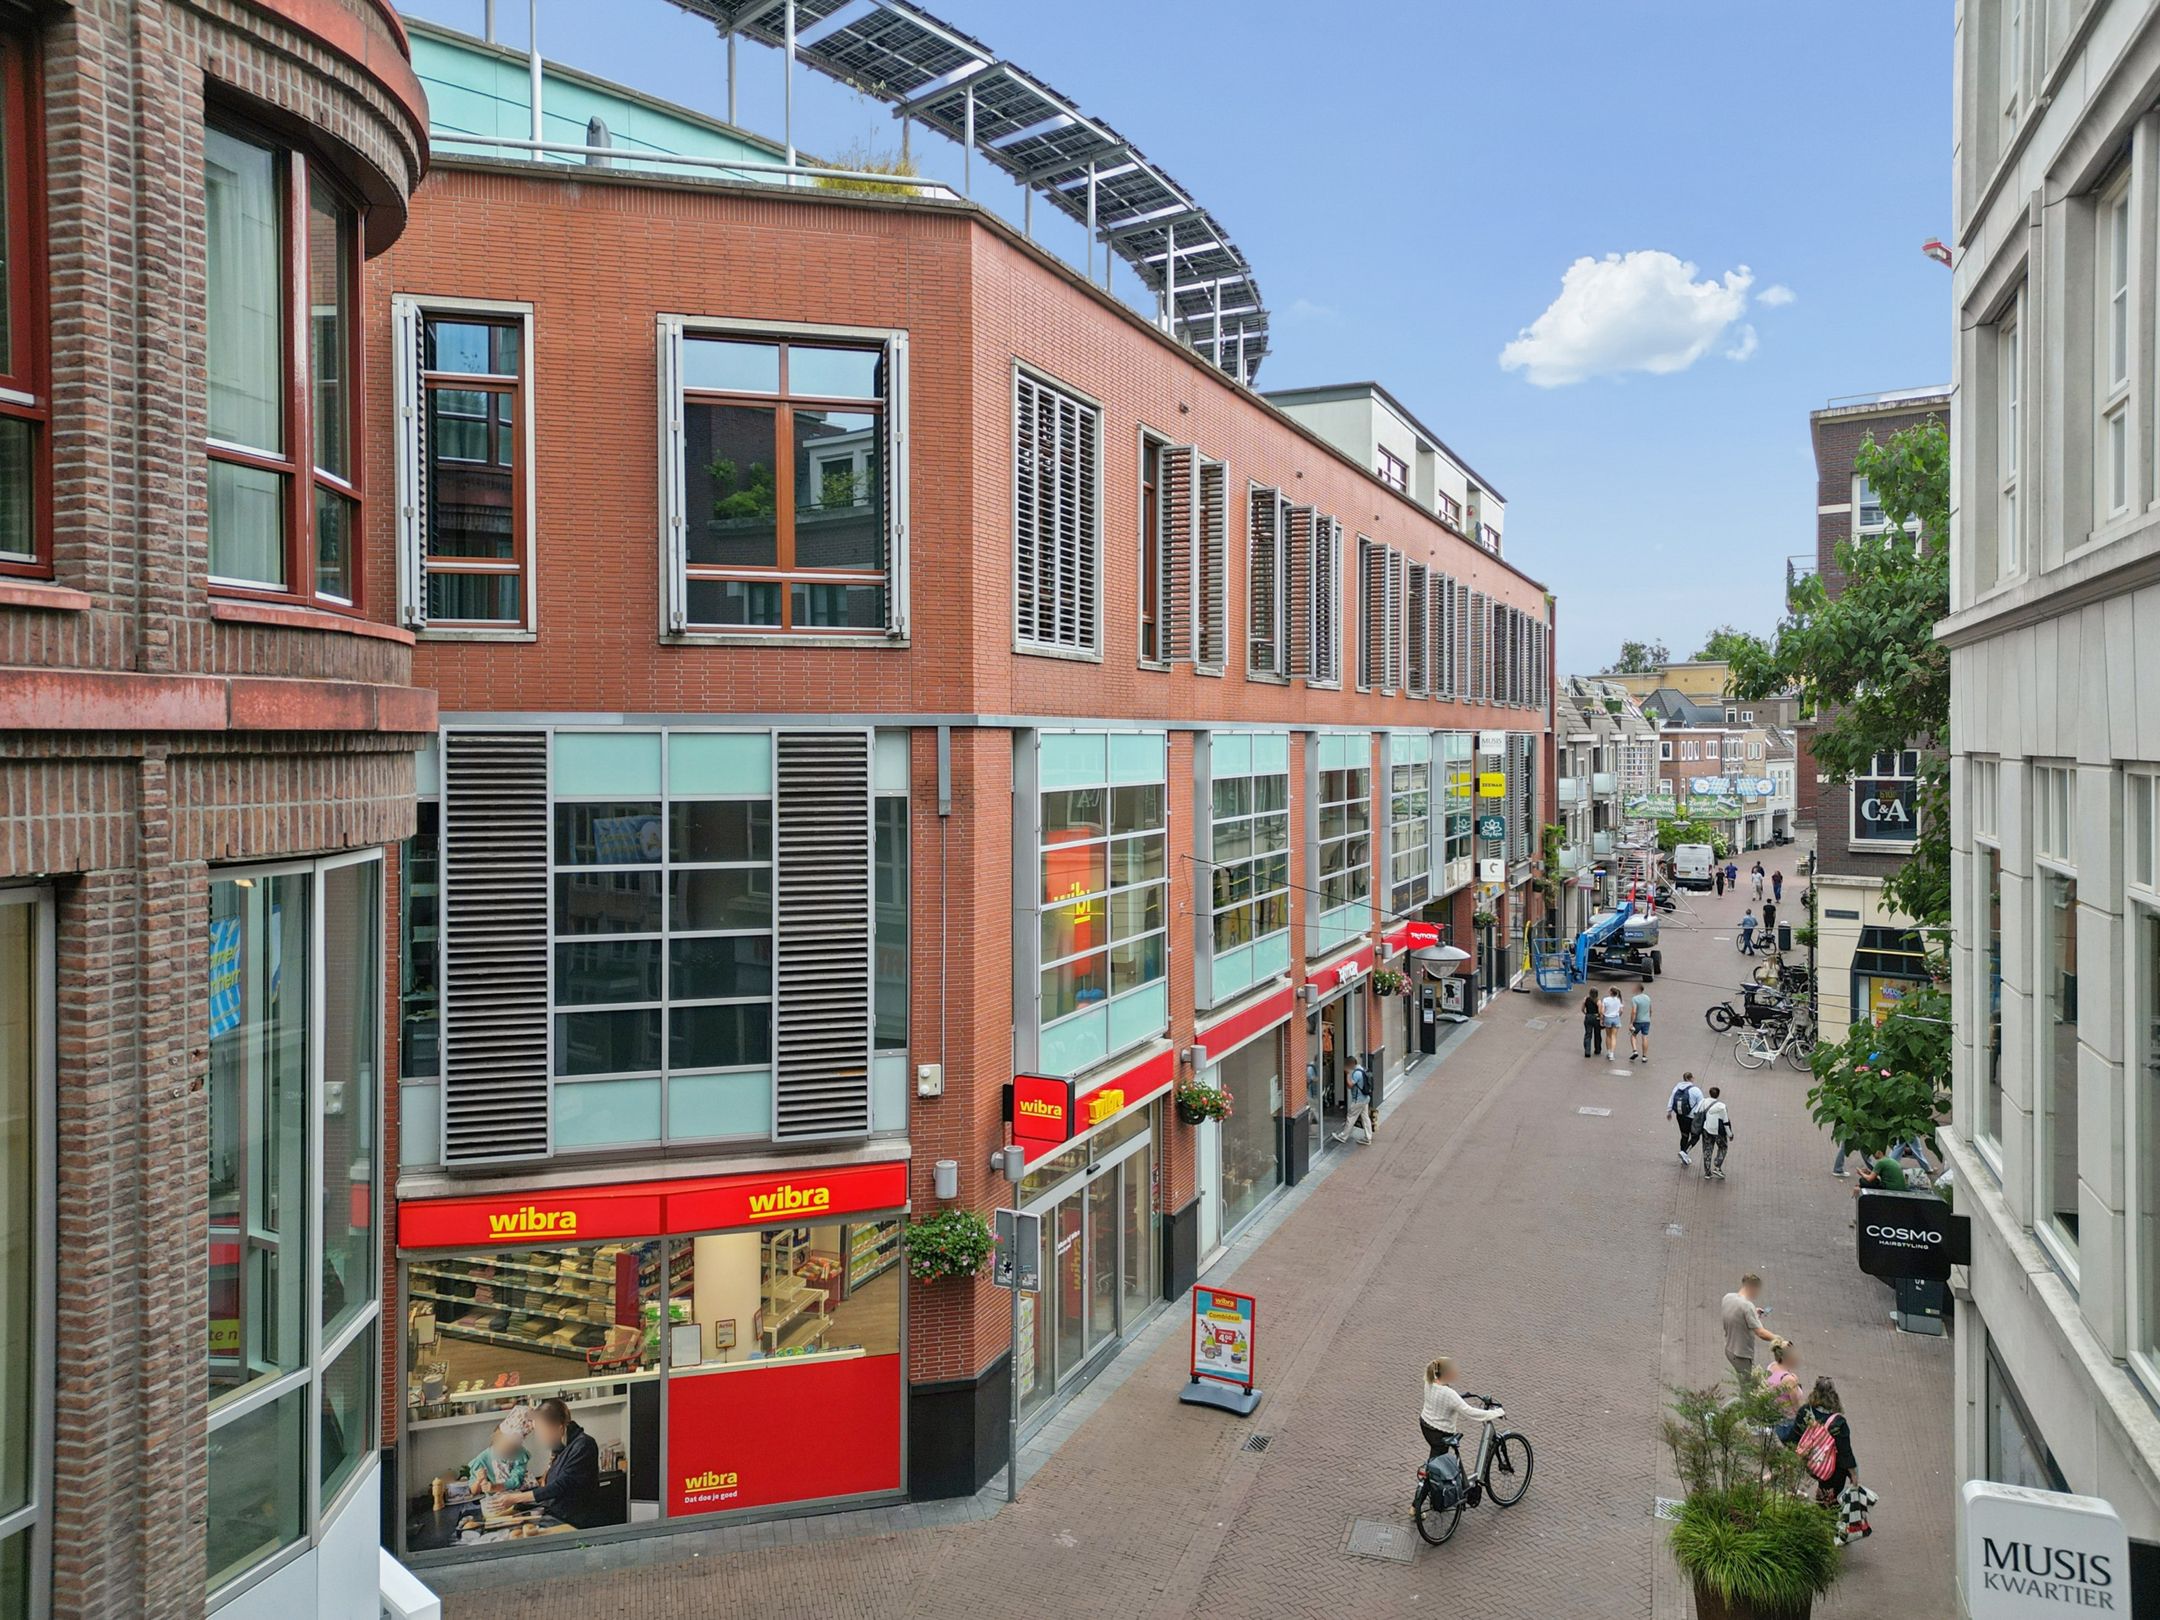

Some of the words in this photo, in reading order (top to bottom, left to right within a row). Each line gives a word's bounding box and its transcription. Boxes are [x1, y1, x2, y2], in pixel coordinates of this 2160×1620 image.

[1861, 798, 1910, 822] C&A
[1020, 1099, 1062, 1117] wibra
[749, 1185, 830, 1213] wibra
[489, 1206, 577, 1232] wibra
[1866, 1225, 1942, 1244] COSMO
[1879, 1240, 1929, 1250] HAIRSTYLING
[1215, 1297, 1235, 1307] wibra
[1208, 1312, 1240, 1321] Combideal
[685, 1471, 738, 1489] wibra
[684, 1496, 697, 1504] Dat
[698, 1494, 712, 1502] doe
[712, 1492, 720, 1501] je
[720, 1490, 738, 1500] goed
[1982, 1537, 2112, 1587] MUSIS
[1984, 1571, 2115, 1611] KWARTIER
